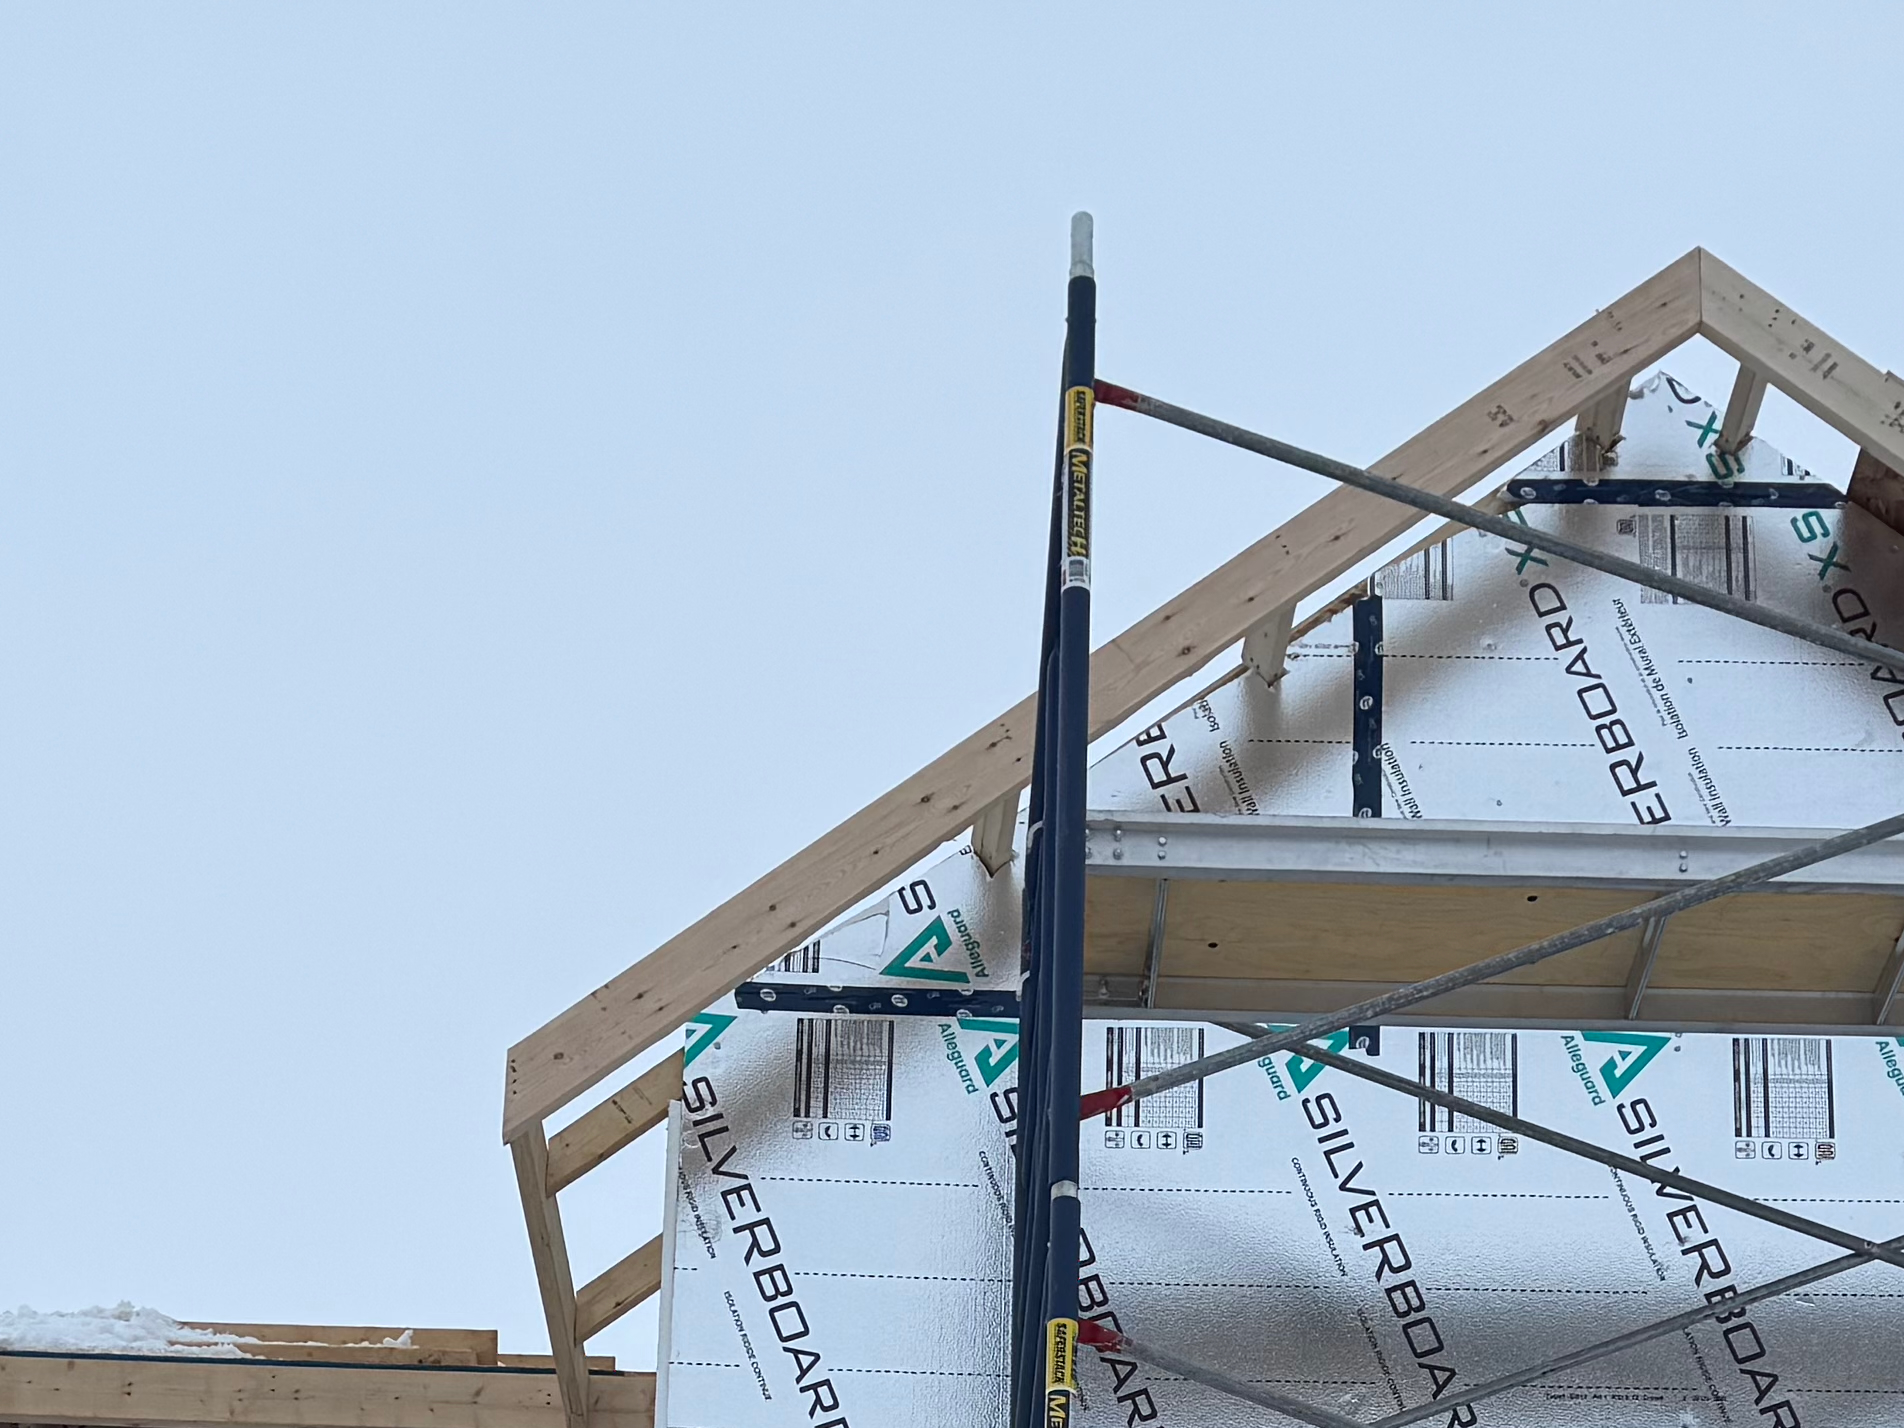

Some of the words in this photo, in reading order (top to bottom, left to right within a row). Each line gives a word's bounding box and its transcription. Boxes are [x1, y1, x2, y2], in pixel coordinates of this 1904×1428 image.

[1067, 451, 1088, 556] METALTECH
[1790, 510, 1850, 581] XS
[945, 909, 990, 978] Alleguard
[938, 1022, 978, 1094] Alleguard
[1561, 1034, 1605, 1106] Alleguard
